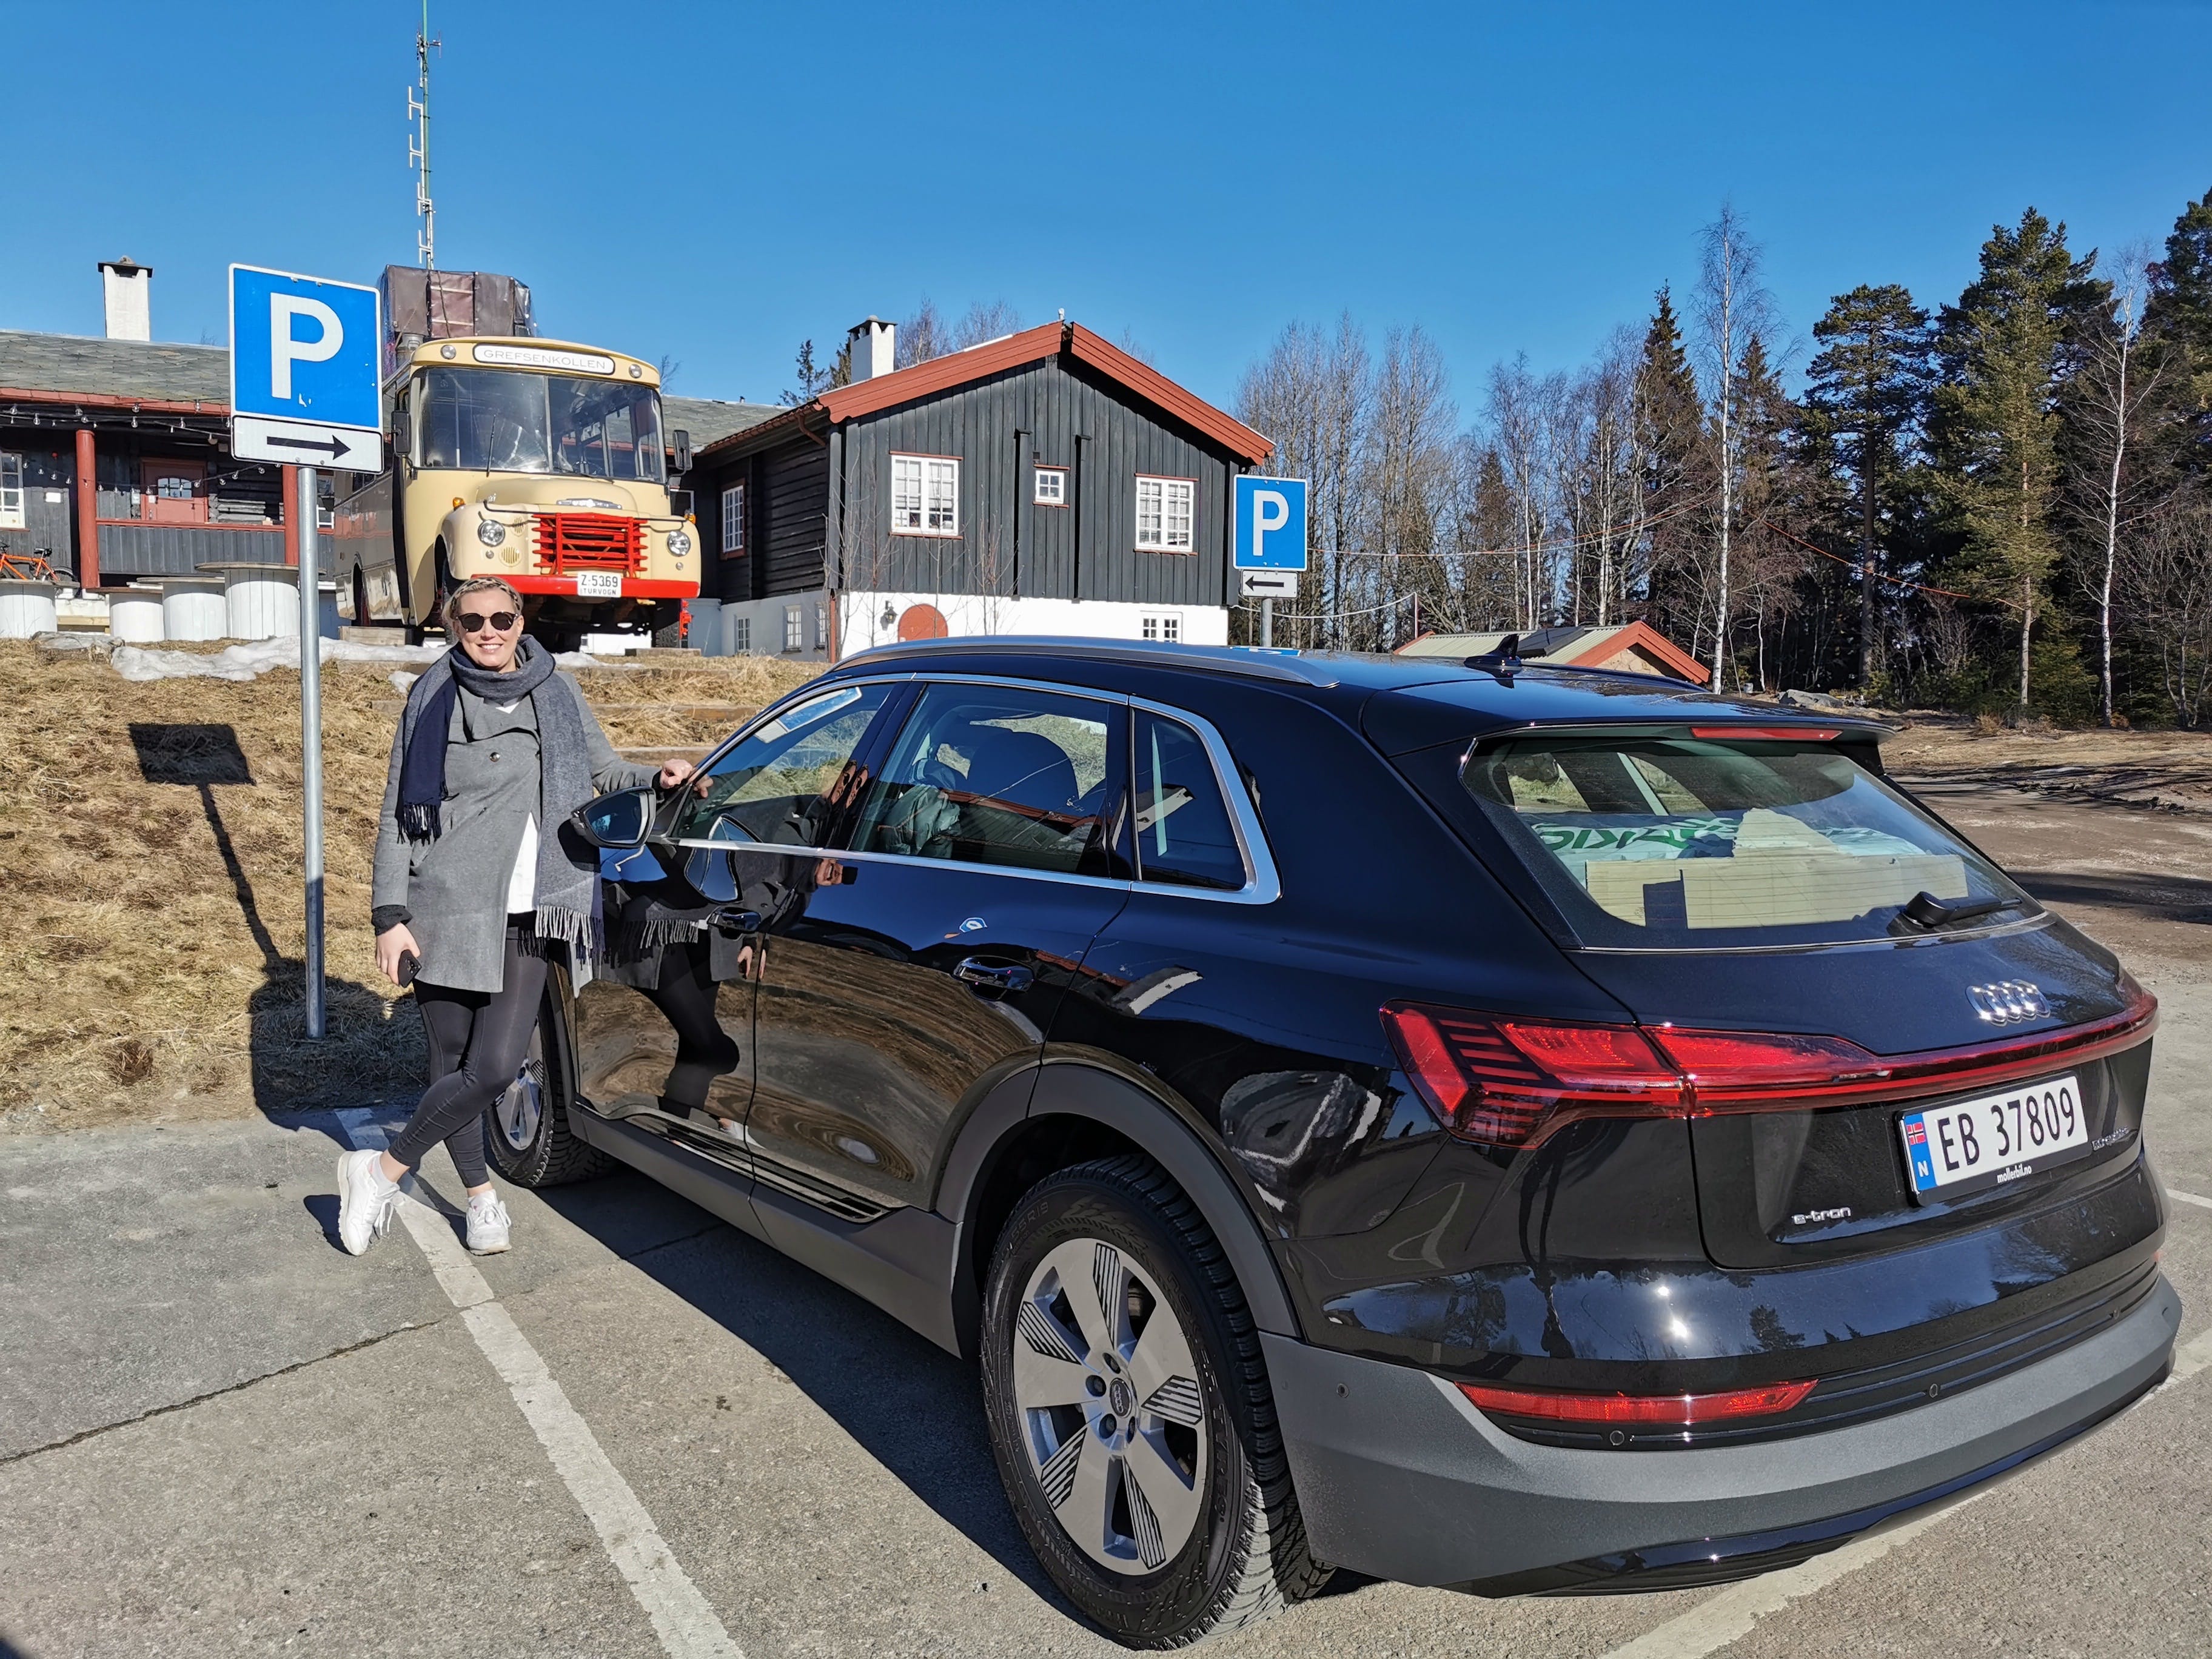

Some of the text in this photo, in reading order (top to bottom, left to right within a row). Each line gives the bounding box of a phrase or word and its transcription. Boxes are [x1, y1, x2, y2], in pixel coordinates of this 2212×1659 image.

[270, 292, 344, 400] P
[484, 349, 606, 369] GREFSENKOLLEN
[1252, 489, 1290, 557] P
[1936, 1087, 2075, 1171] EB 37809
[1917, 1160, 1929, 1178] N
[1997, 1163, 2033, 1184] mollerbil.no
[1793, 1207, 1851, 1225] e-tron
